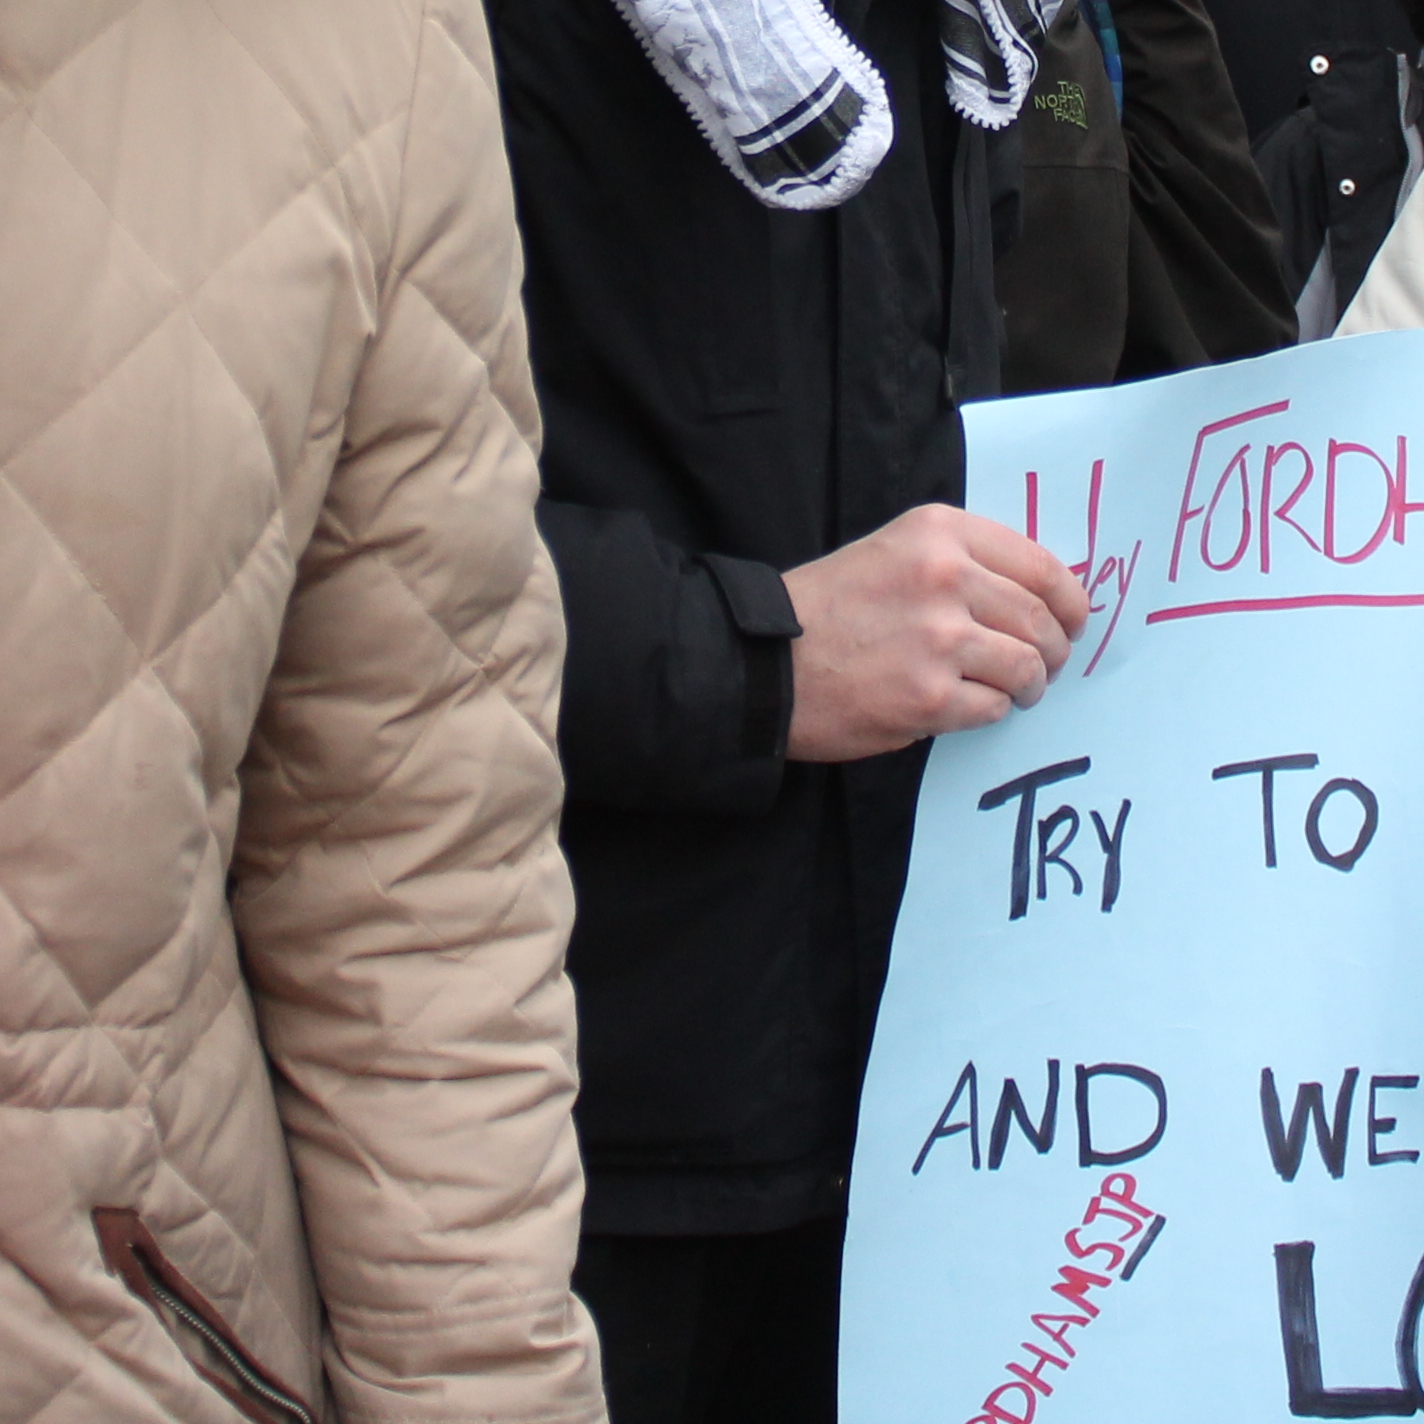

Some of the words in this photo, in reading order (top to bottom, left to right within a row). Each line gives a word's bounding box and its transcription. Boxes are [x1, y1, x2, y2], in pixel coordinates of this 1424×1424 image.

[1034, 93, 1081, 110] NORT
[1053, 108, 1081, 126] FAC
[1211, 752, 1379, 873] TO
[911, 1057, 1168, 1176] AND
[964, 1172, 1156, 1424] DHAMSJP
